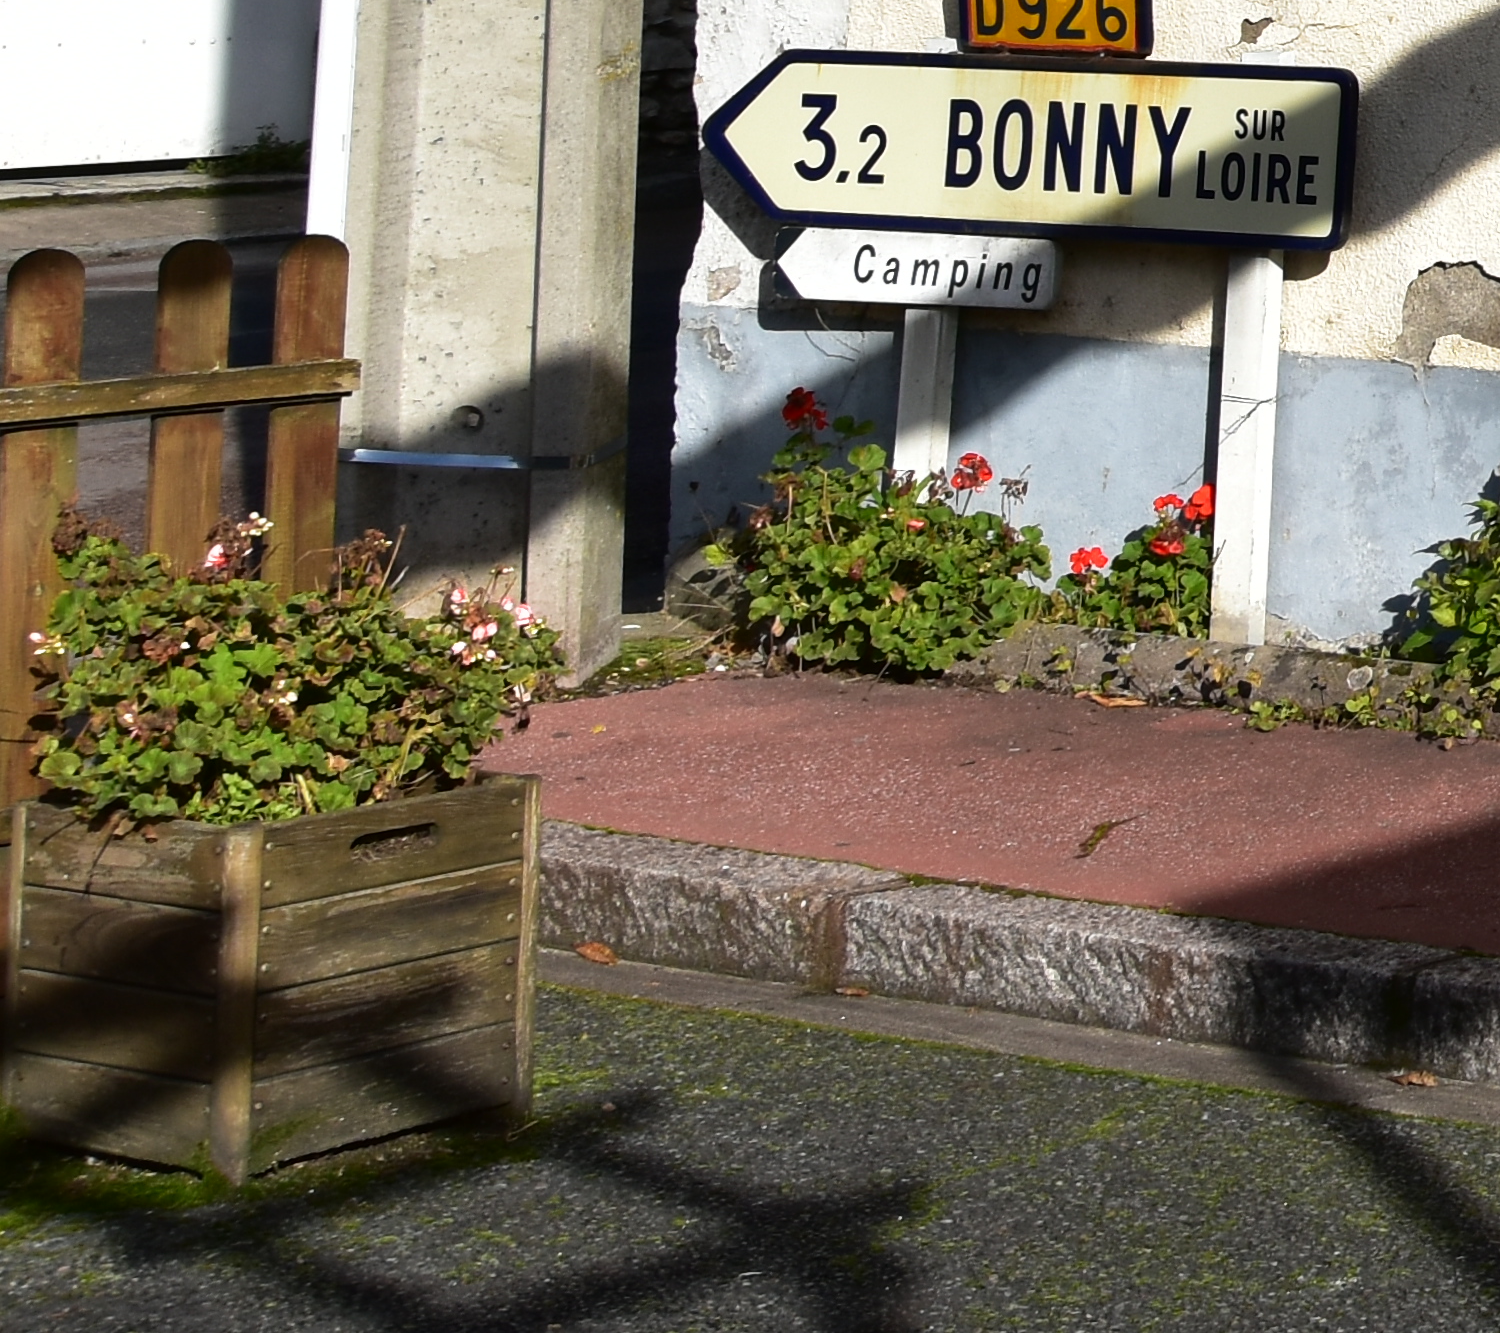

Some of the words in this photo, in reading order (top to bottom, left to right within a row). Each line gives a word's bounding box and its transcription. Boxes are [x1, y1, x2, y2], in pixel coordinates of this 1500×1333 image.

[943, 97, 1193, 199] BONNY
[1233, 107, 1287, 142] SUR
[1195, 149, 1320, 206] LOIRE
[852, 243, 1043, 302] Camping
